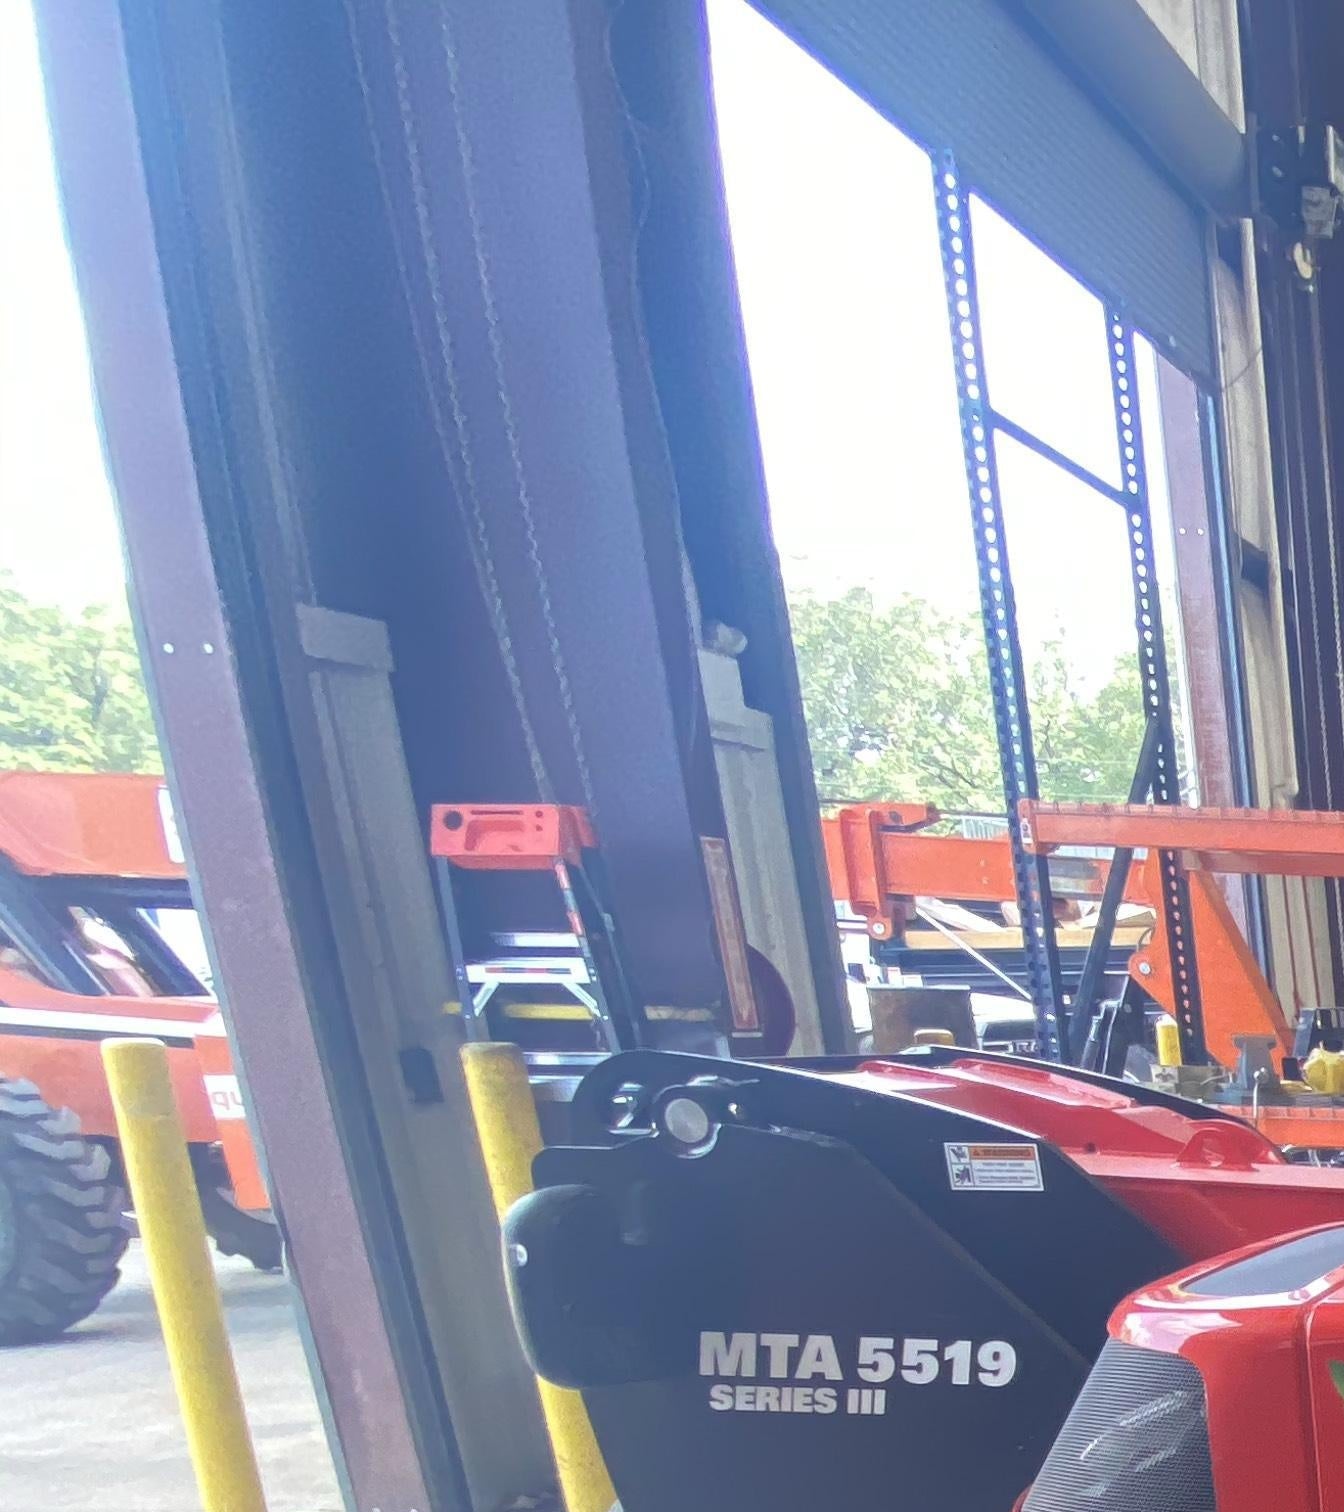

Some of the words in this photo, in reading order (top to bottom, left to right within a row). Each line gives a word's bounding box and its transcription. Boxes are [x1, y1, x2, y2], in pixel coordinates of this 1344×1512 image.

[699, 1331, 843, 1380] MTA
[857, 1336, 1017, 1387] 5519
[709, 1384, 837, 1413] SERIES
[847, 1388, 886, 1415] III
